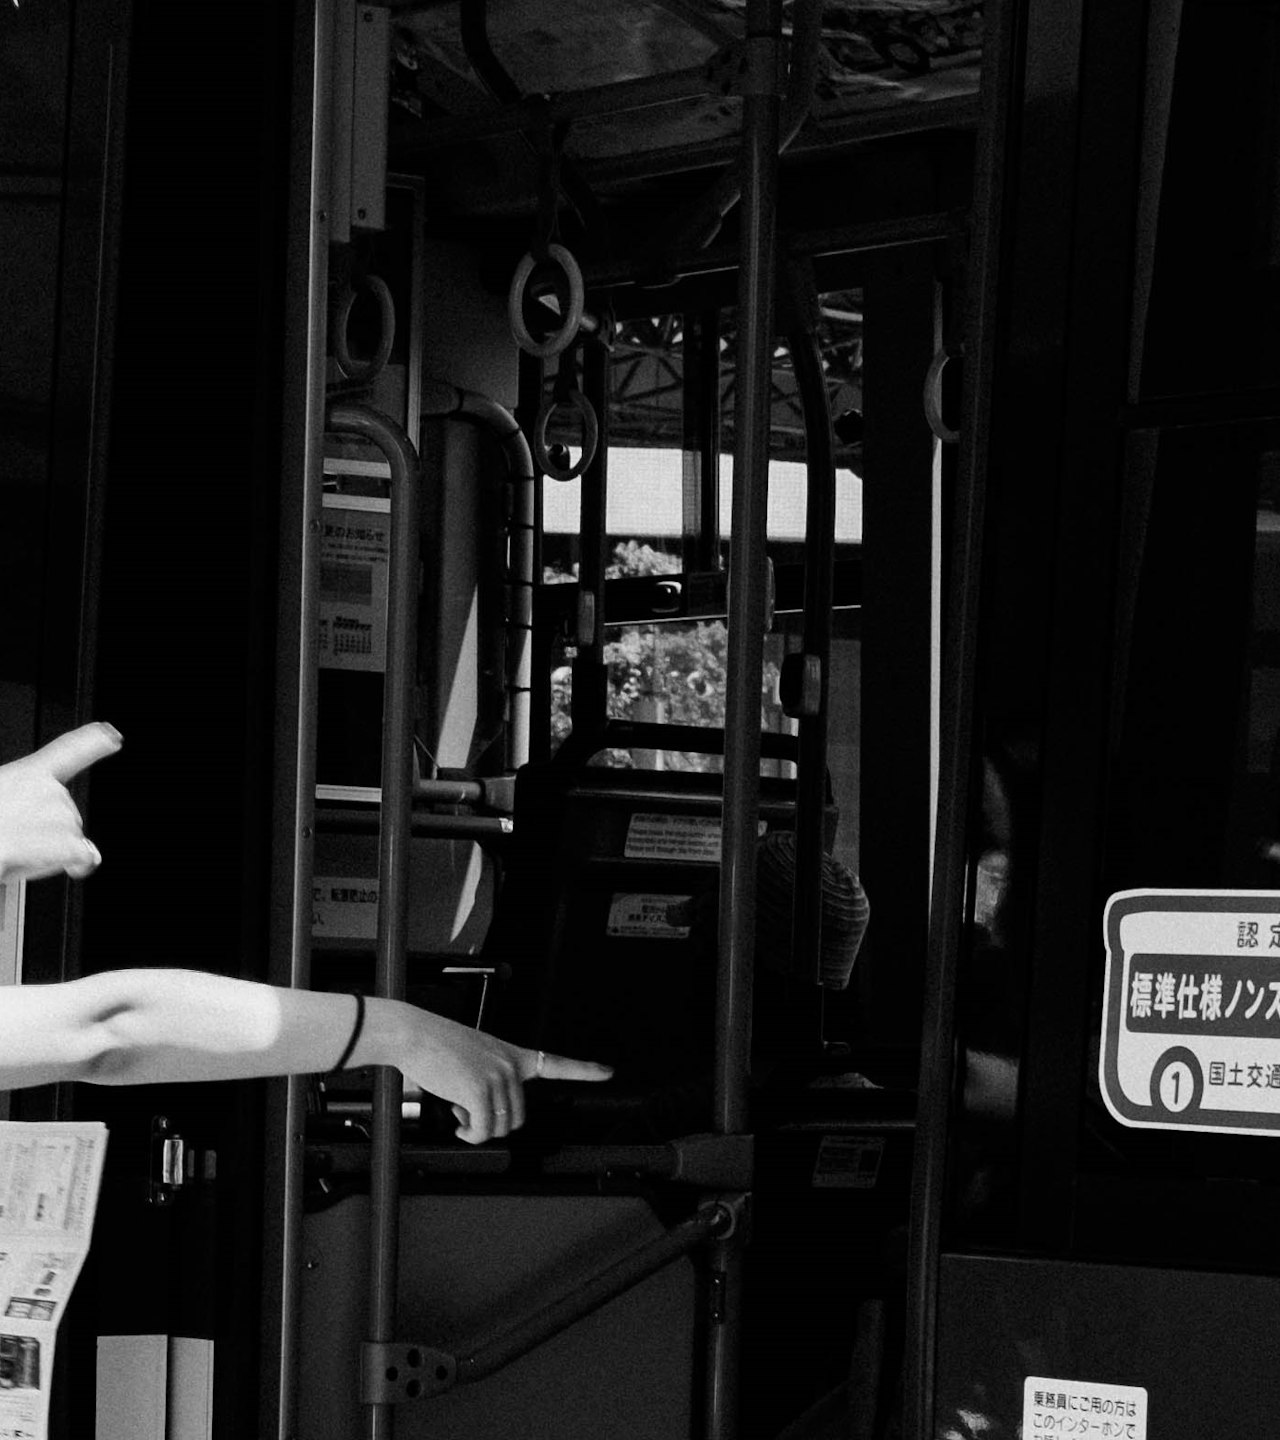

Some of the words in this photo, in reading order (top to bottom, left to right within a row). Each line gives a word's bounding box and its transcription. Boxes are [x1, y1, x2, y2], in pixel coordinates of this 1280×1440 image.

[1033, 1390, 1137, 1417] 乗務員にご用の方は
[1033, 1413, 1136, 1439] このインターホンで
